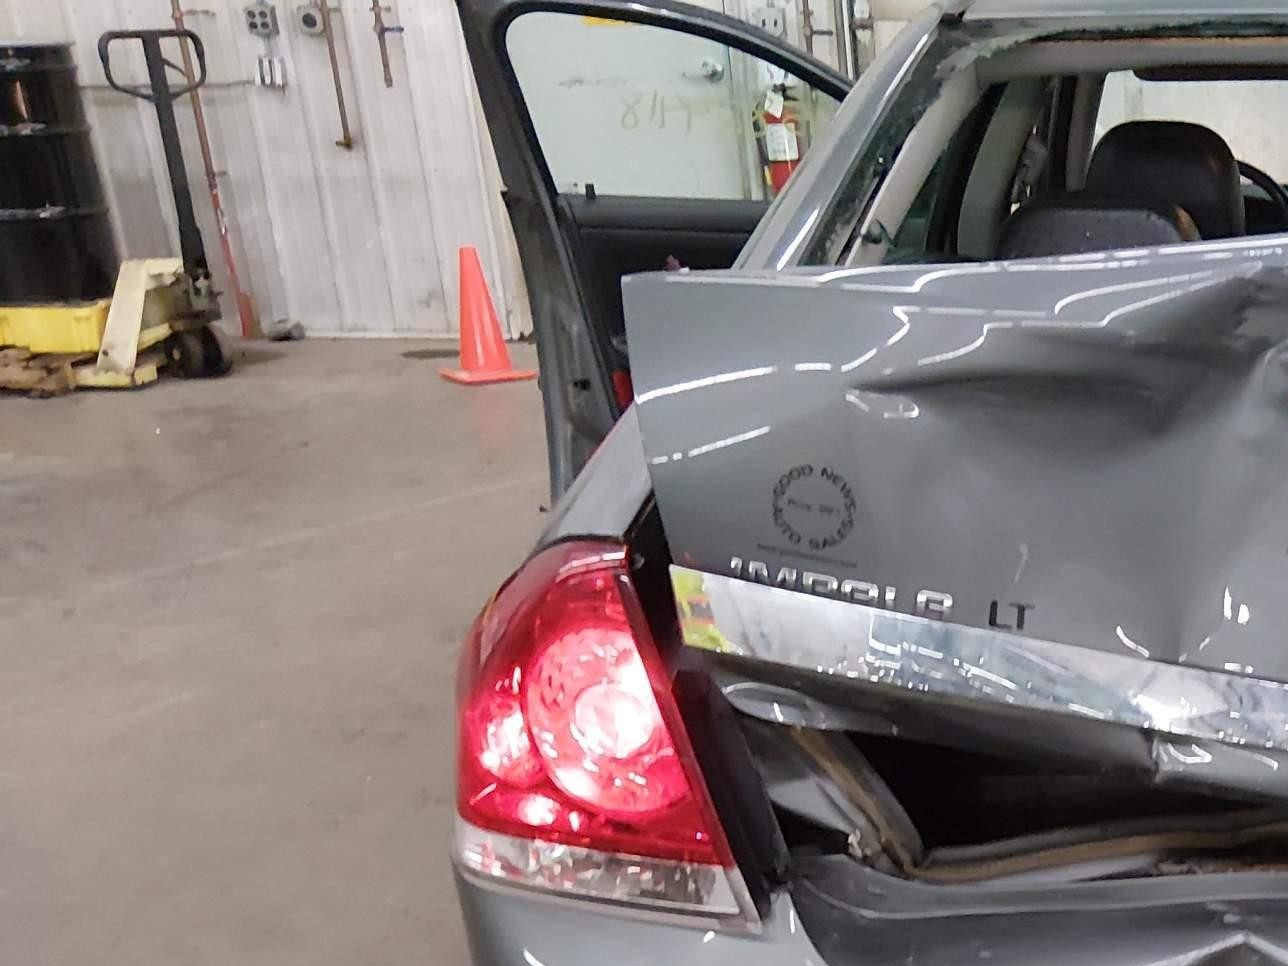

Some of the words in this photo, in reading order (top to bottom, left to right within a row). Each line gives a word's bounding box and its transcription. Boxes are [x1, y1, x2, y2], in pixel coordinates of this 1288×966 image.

[773, 463, 814, 497] GOOD
[821, 466, 857, 512] NEWS
[988, 599, 1036, 631] LT
